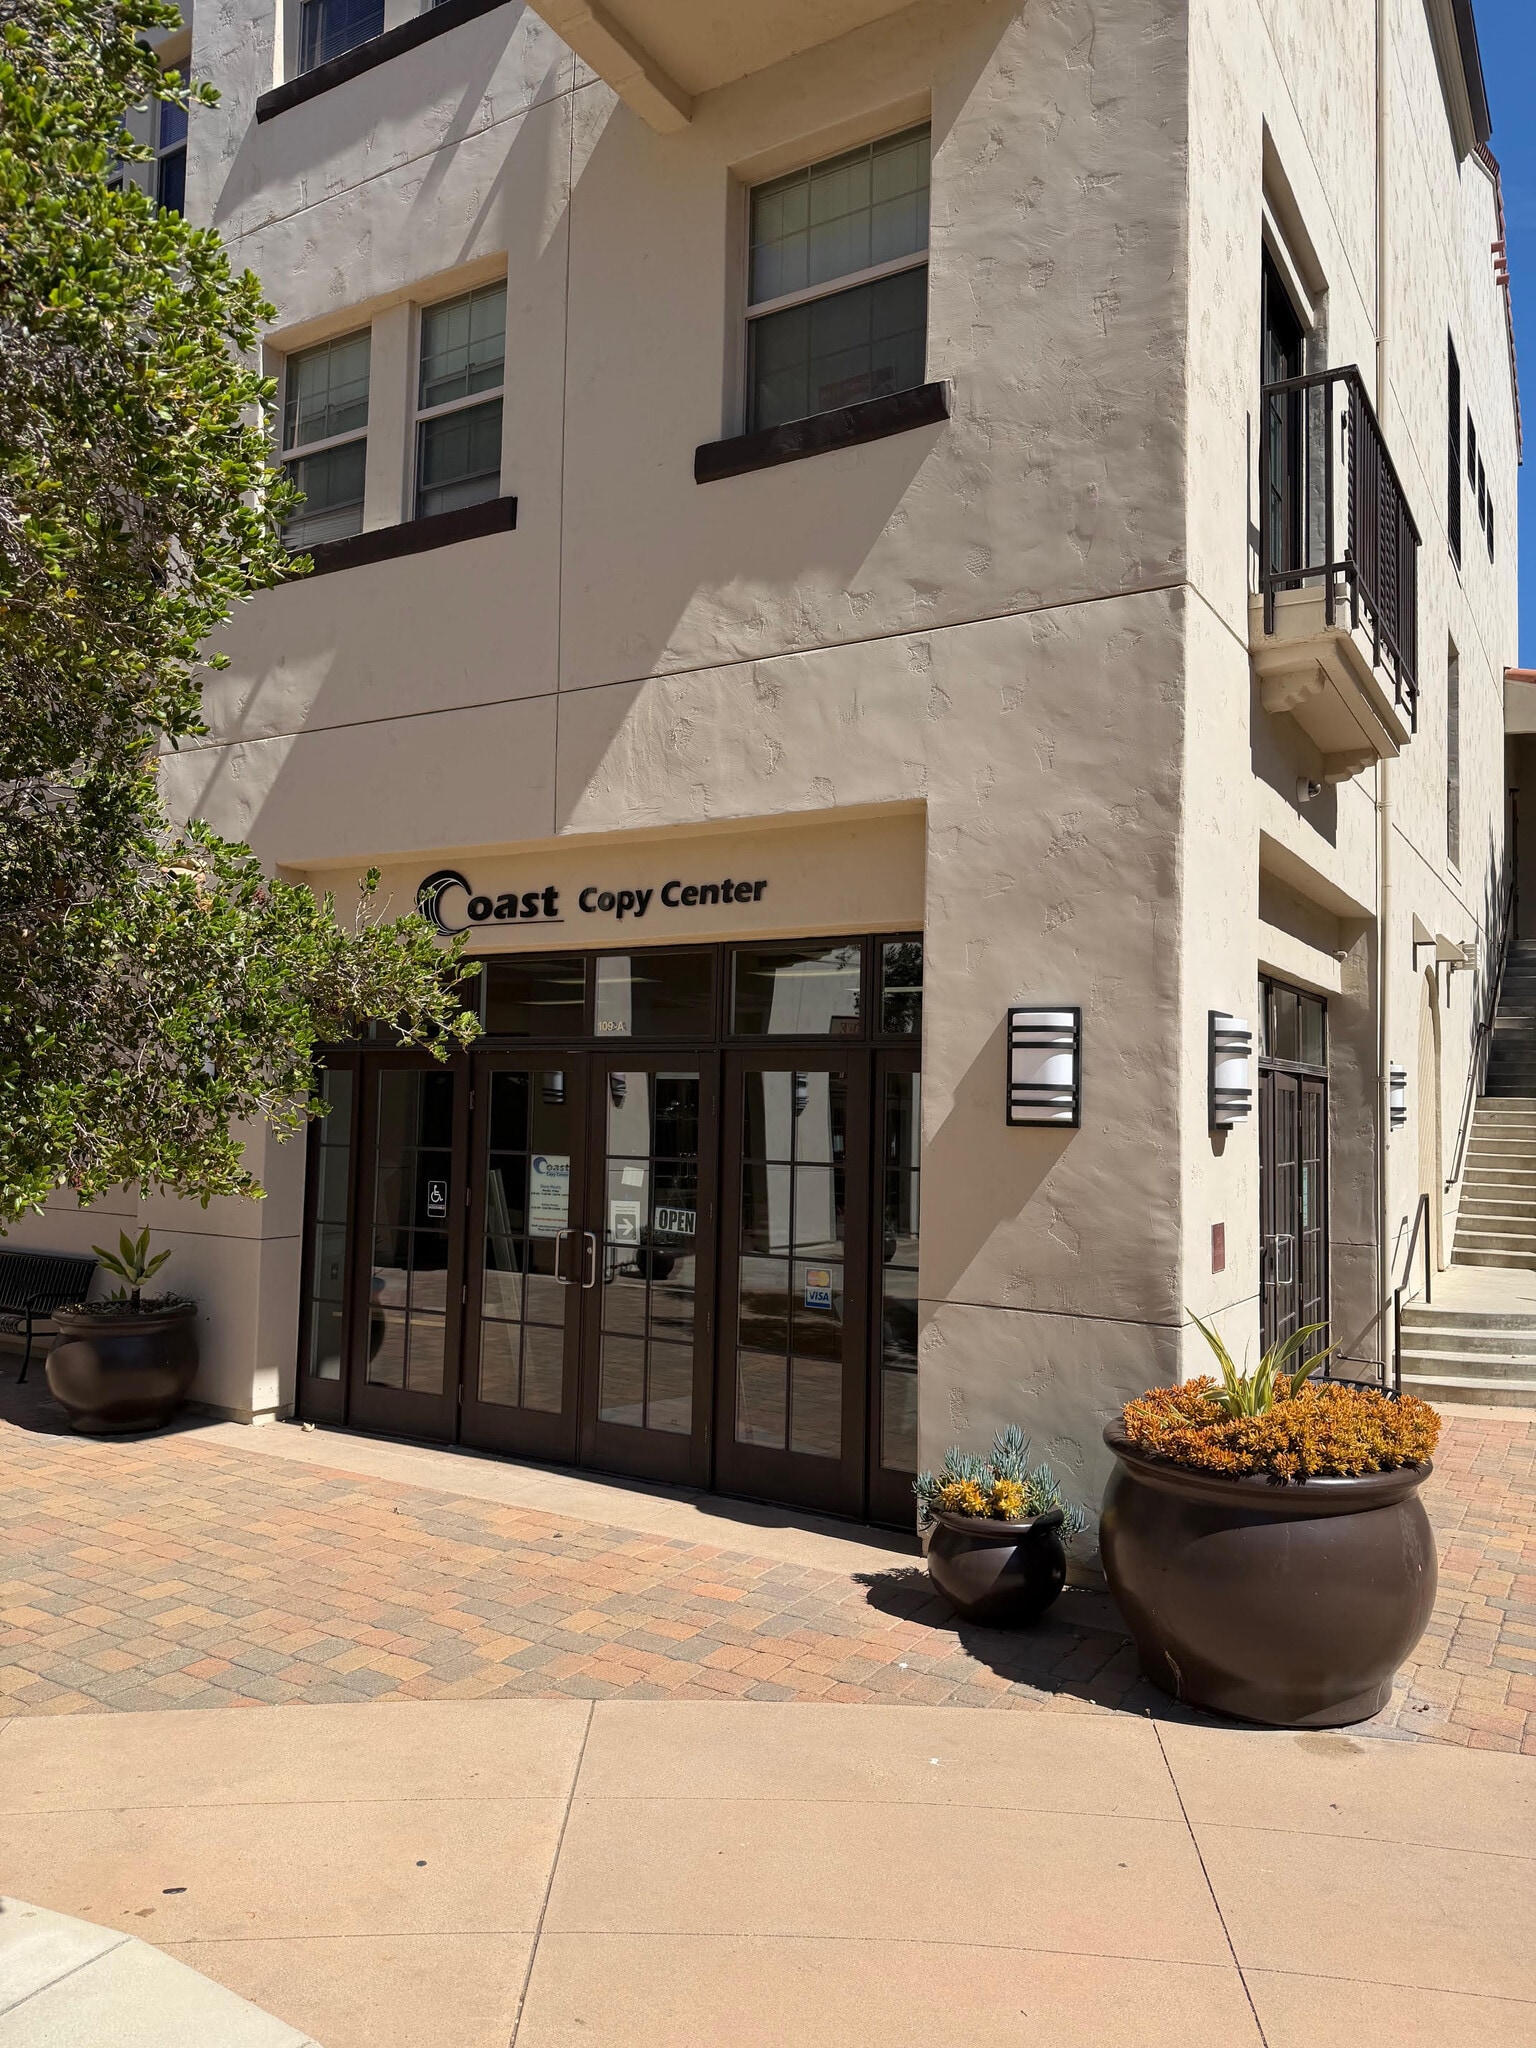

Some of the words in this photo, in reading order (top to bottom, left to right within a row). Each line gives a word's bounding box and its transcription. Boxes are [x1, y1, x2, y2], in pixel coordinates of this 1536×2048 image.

[417, 870, 560, 936] Coast
[578, 887, 653, 920] Copy
[661, 879, 768, 908] Center
[598, 1021, 624, 1031] 109-A
[533, 1157, 570, 1174] Coast
[658, 1208, 694, 1233] OPEN
[809, 1291, 829, 1301] VISA
